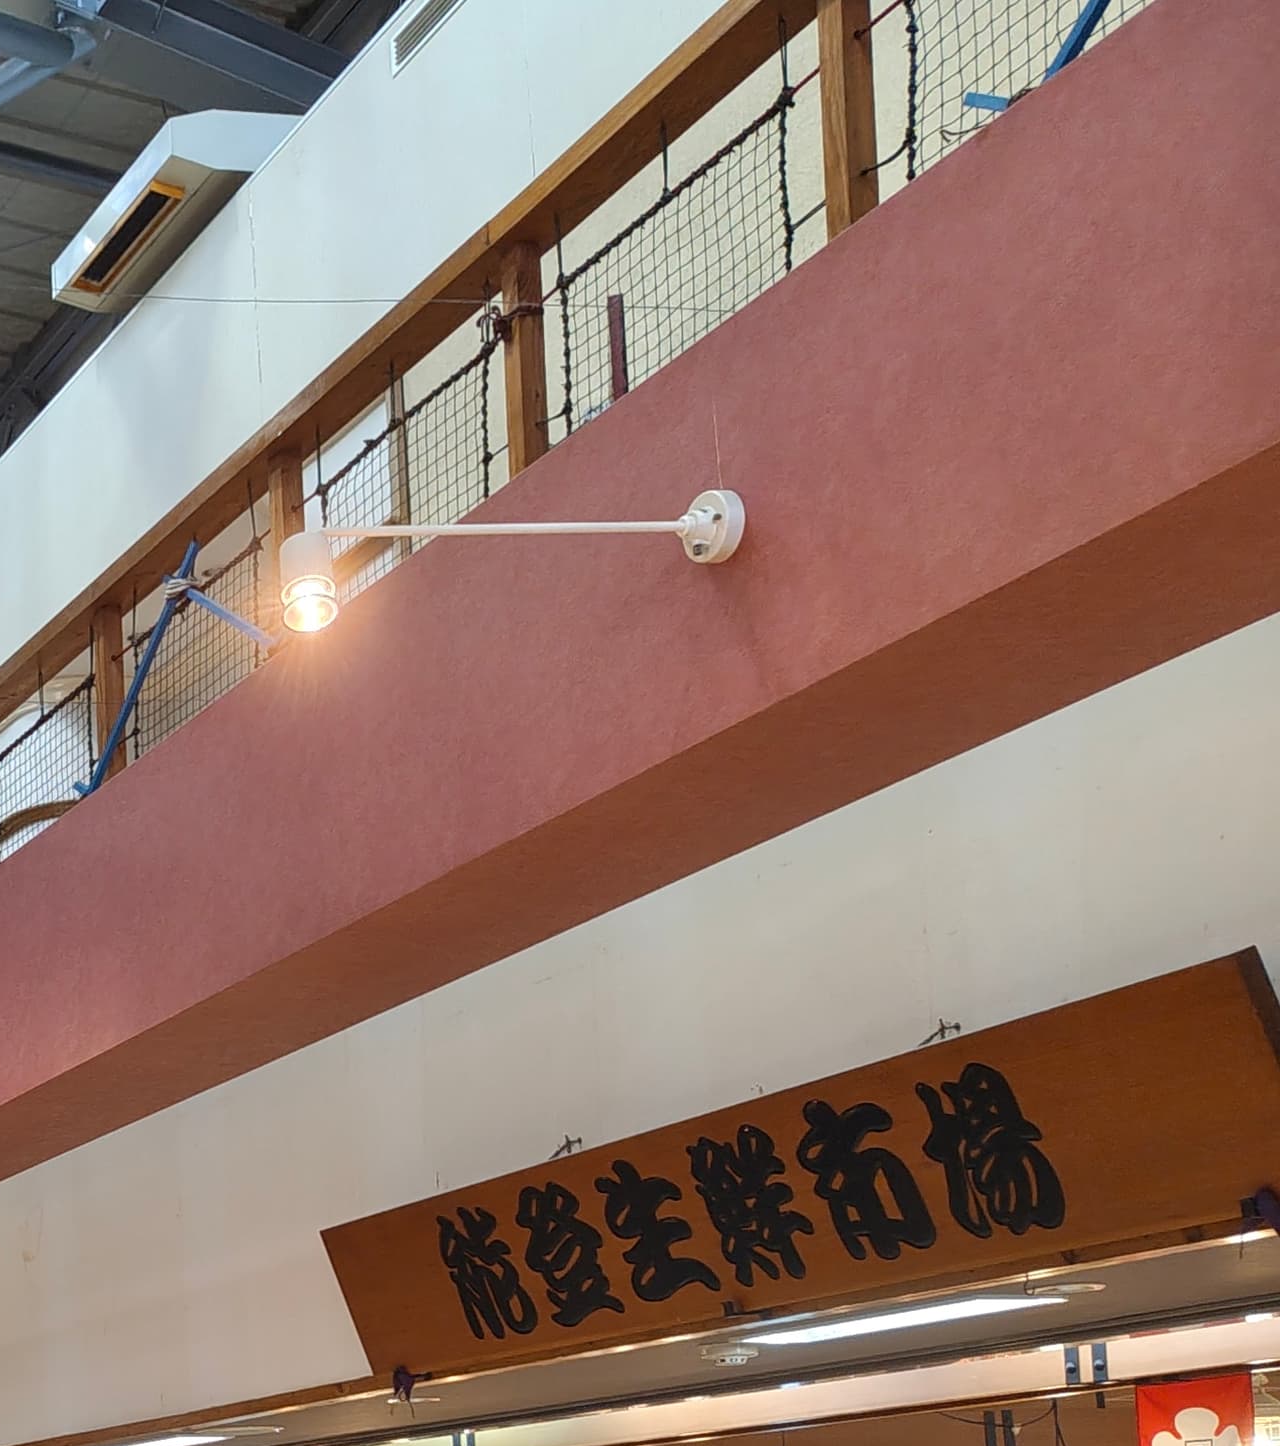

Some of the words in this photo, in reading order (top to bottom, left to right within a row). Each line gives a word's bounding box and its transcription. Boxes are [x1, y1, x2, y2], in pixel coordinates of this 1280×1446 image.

[438, 1062, 1065, 1341] 能登生鮮市場
